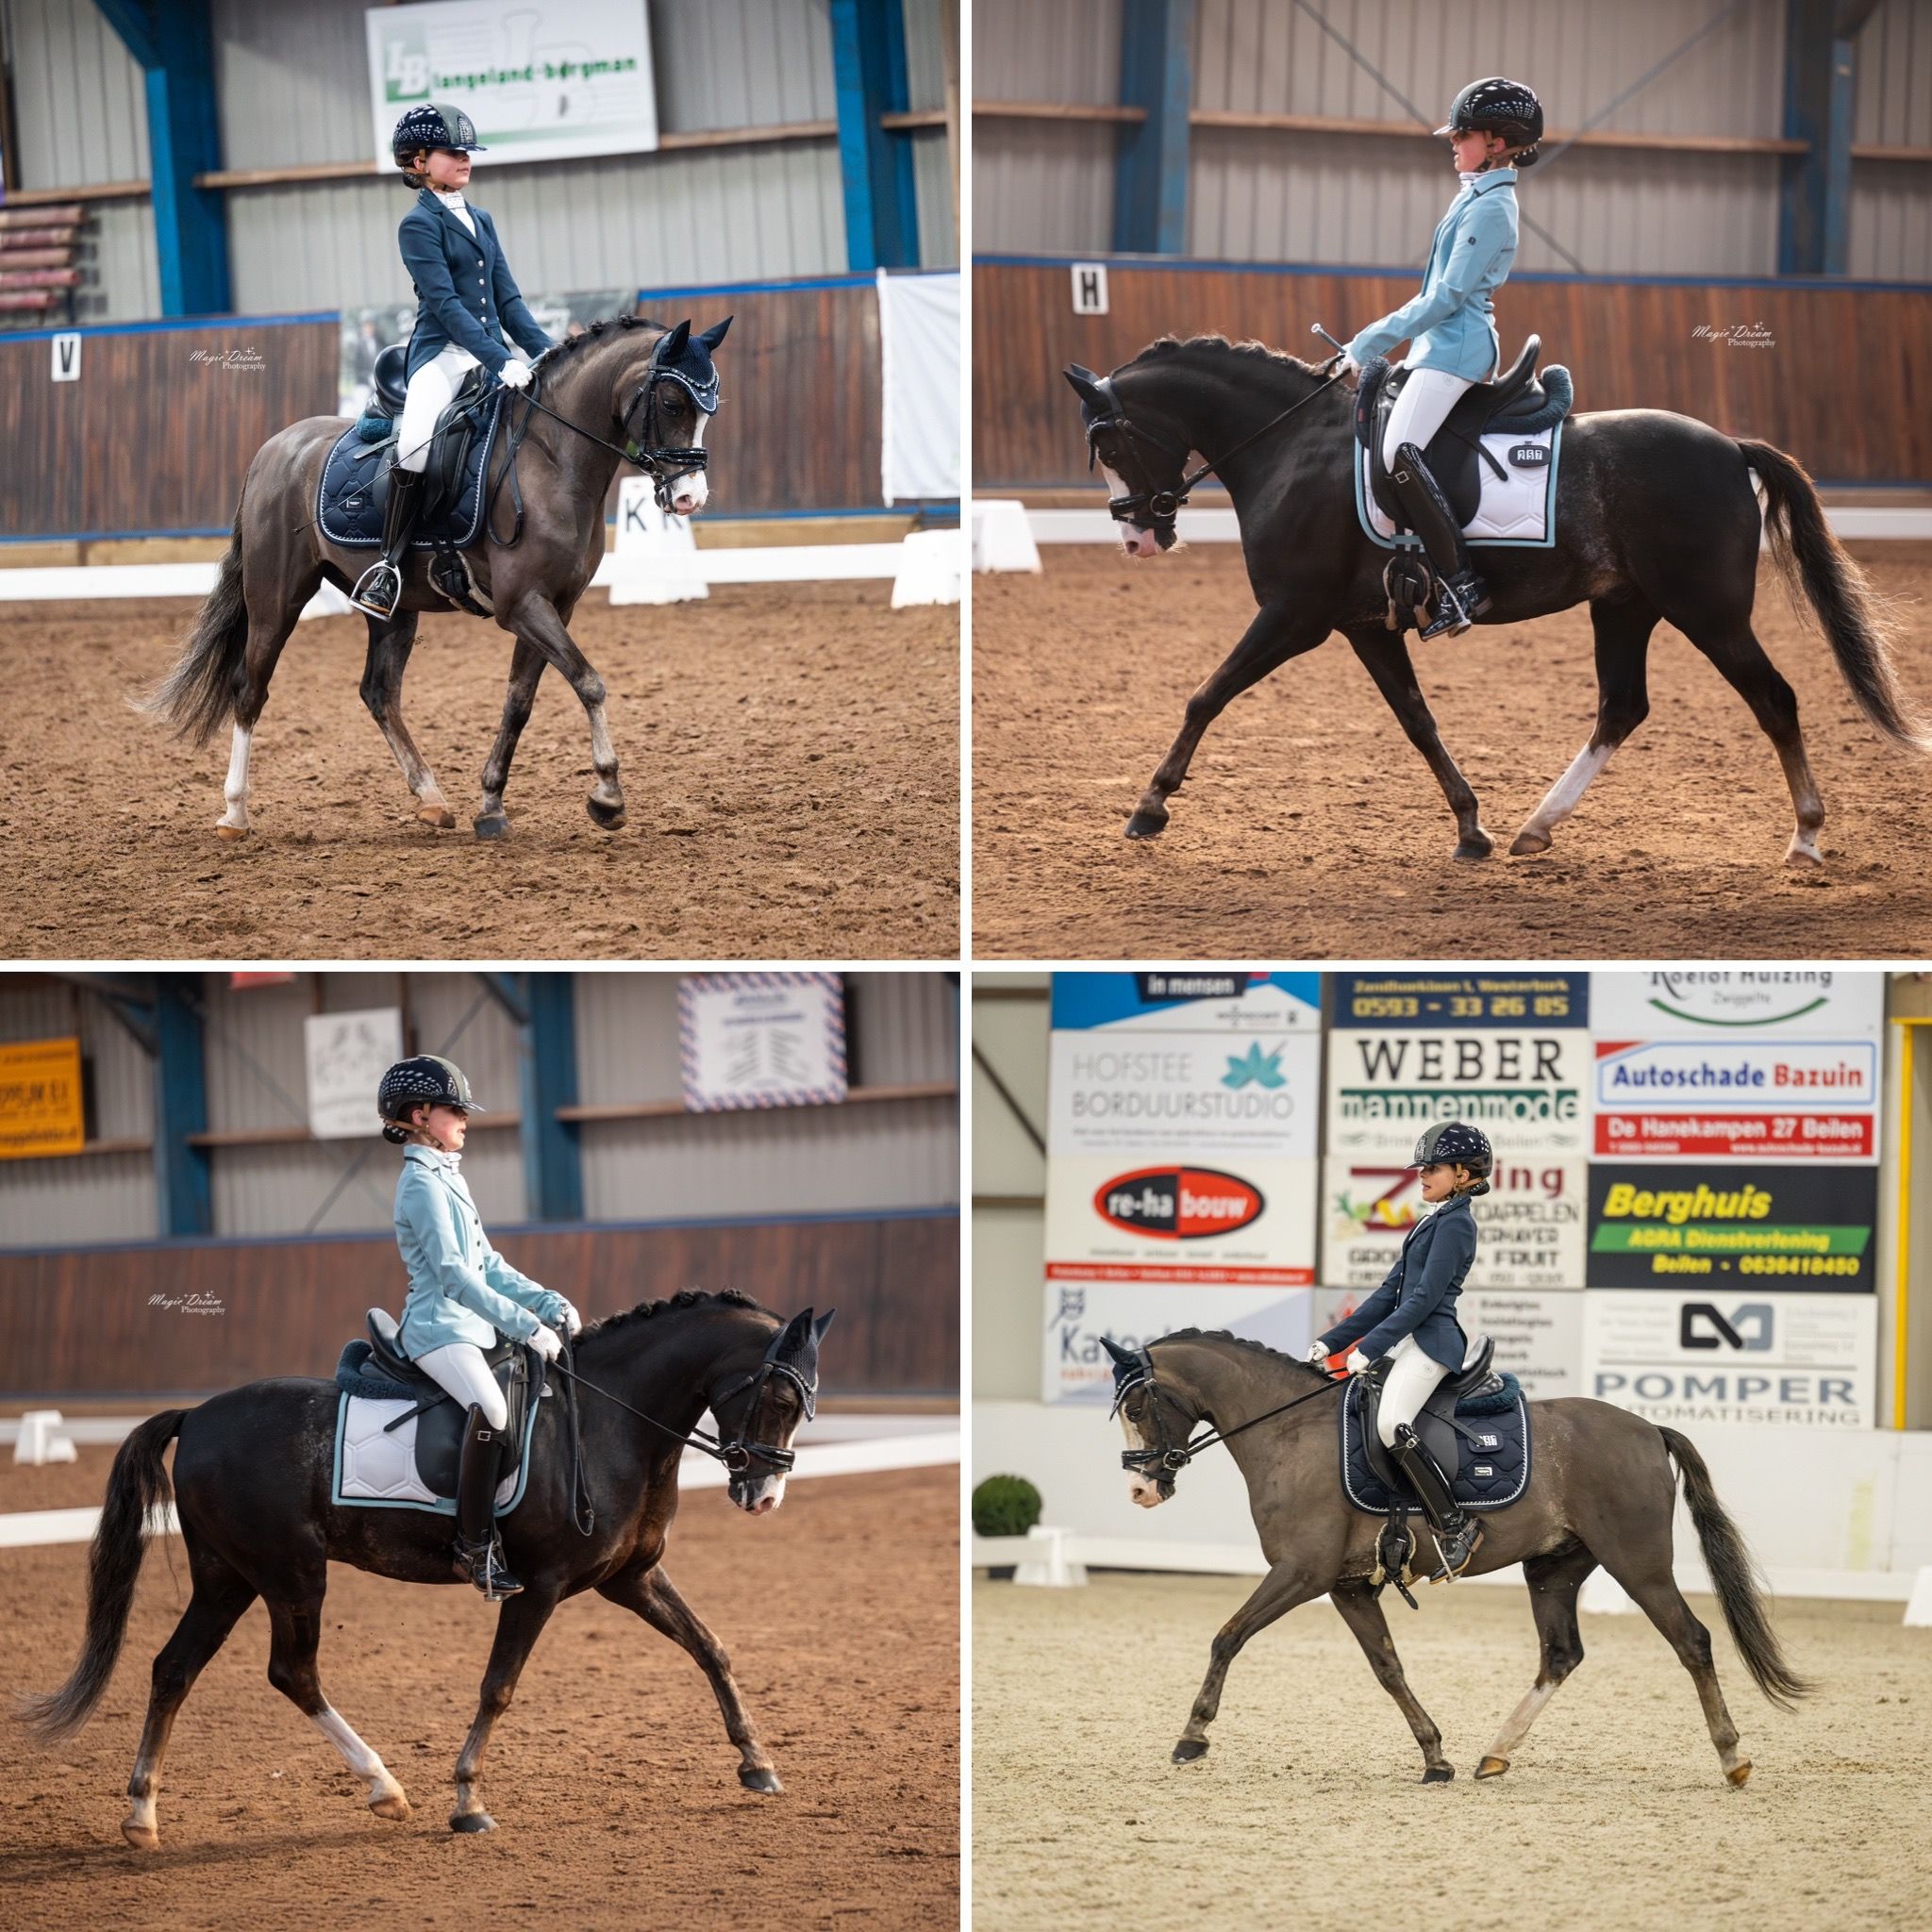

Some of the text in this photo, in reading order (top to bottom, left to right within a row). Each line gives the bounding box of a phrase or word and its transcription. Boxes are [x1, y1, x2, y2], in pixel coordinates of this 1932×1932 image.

[1081, 272, 1099, 307] H
[59, 341, 74, 373] V
[625, 497, 647, 533] K
[1147, 974, 1235, 994] in mensen
[1352, 996, 1419, 1017] 0593
[1449, 996, 1484, 1017] 33
[1491, 996, 1526, 1017] 26
[1533, 996, 1570, 1017] 85
[1072, 1052, 1192, 1083] HOFSTEE
[1357, 1040, 1564, 1081] WEBER
[1611, 1063, 1863, 1087] Autoschade Bazuin
[1072, 1091, 1295, 1121] BORDUURSTUDIO
[1340, 1091, 1578, 1120] mannenmode
[1607, 1117, 1636, 1138] De
[1772, 1118, 1797, 1139] 27
[1802, 1119, 1863, 1139] Beilen
[1108, 1187, 1248, 1218] re-ha bouw
[1602, 1183, 1773, 1224] Berghuis
[1685, 1229, 1831, 1253] Dienstverlening
[1495, 1249, 1559, 1265] FRUIT
[1652, 1254, 1712, 1274] Beilen
[1593, 1373, 1857, 1405] POMPER
[1627, 1402, 1861, 1425] TOMATISERING
